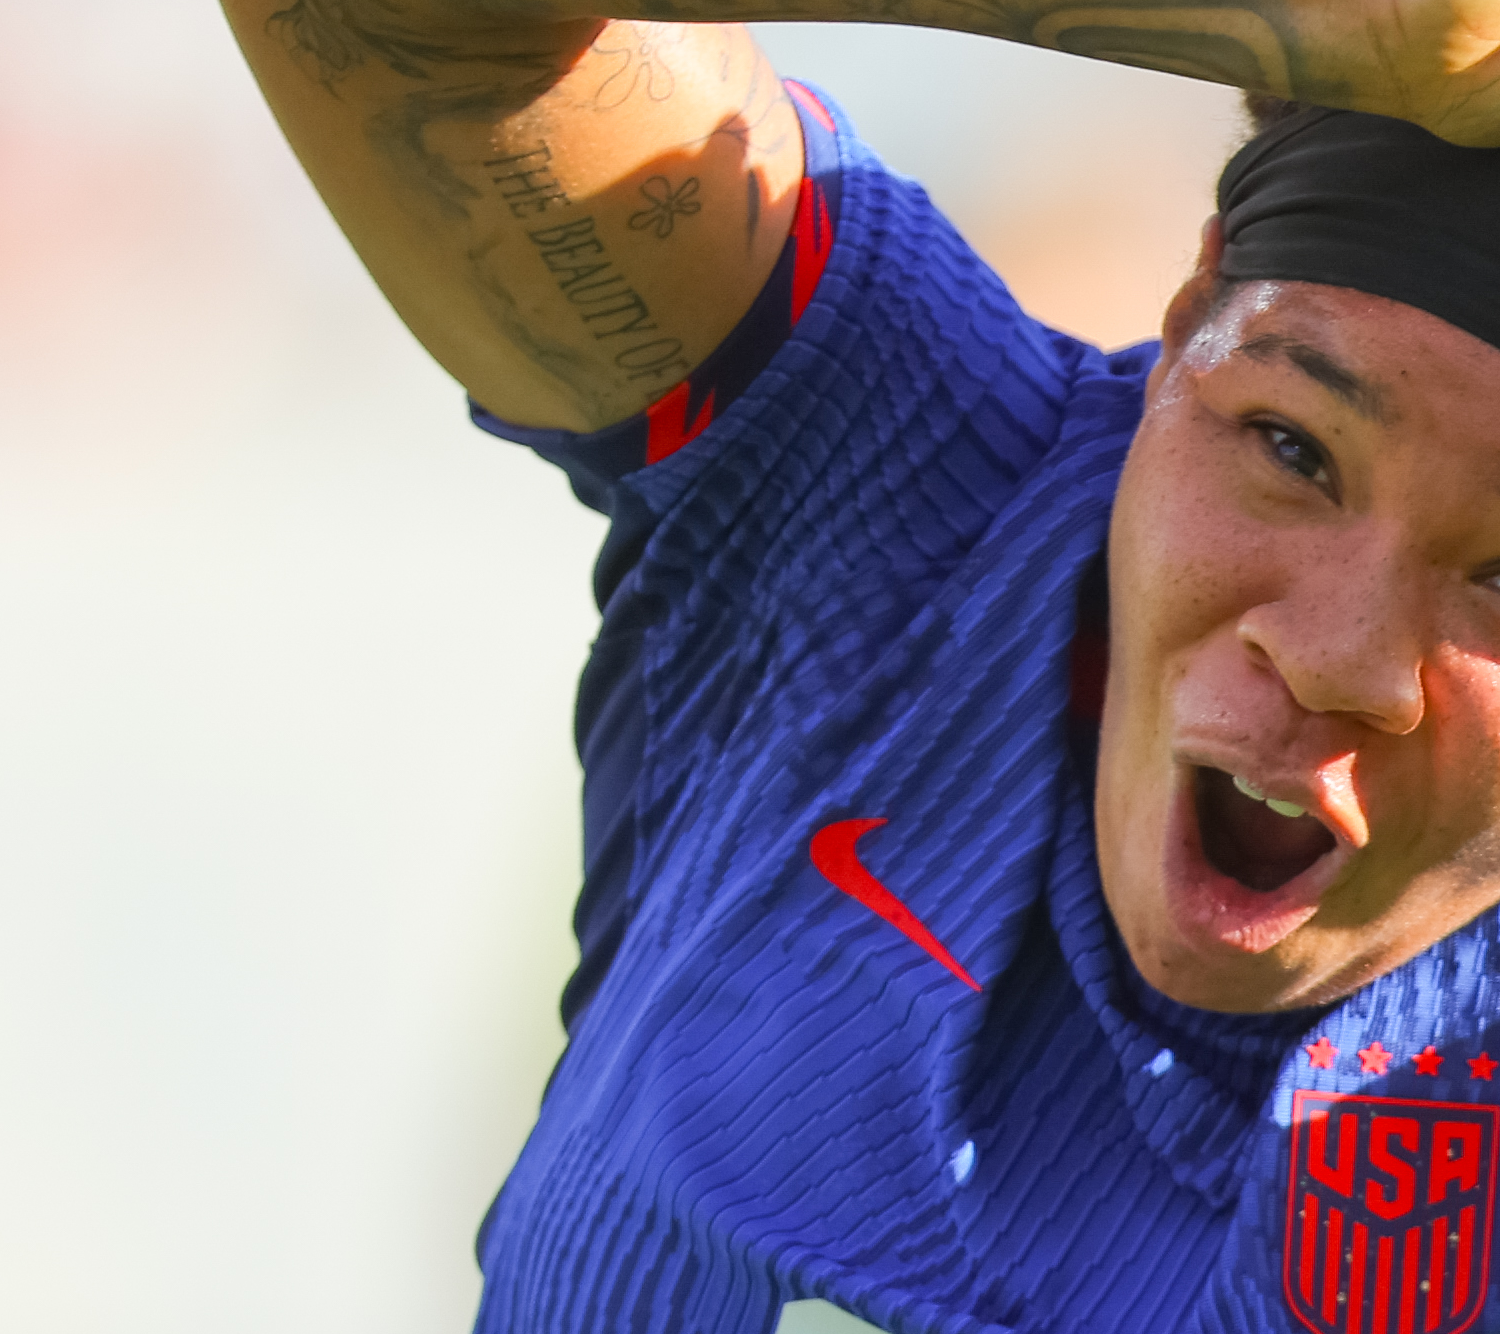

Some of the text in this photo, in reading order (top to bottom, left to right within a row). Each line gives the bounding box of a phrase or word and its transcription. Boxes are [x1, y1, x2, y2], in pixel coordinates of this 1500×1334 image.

[484, 139, 571, 218] THE
[526, 216, 657, 340] BEAUTY
[614, 338, 690, 381] OF
[1307, 1109, 1482, 1221] USA
